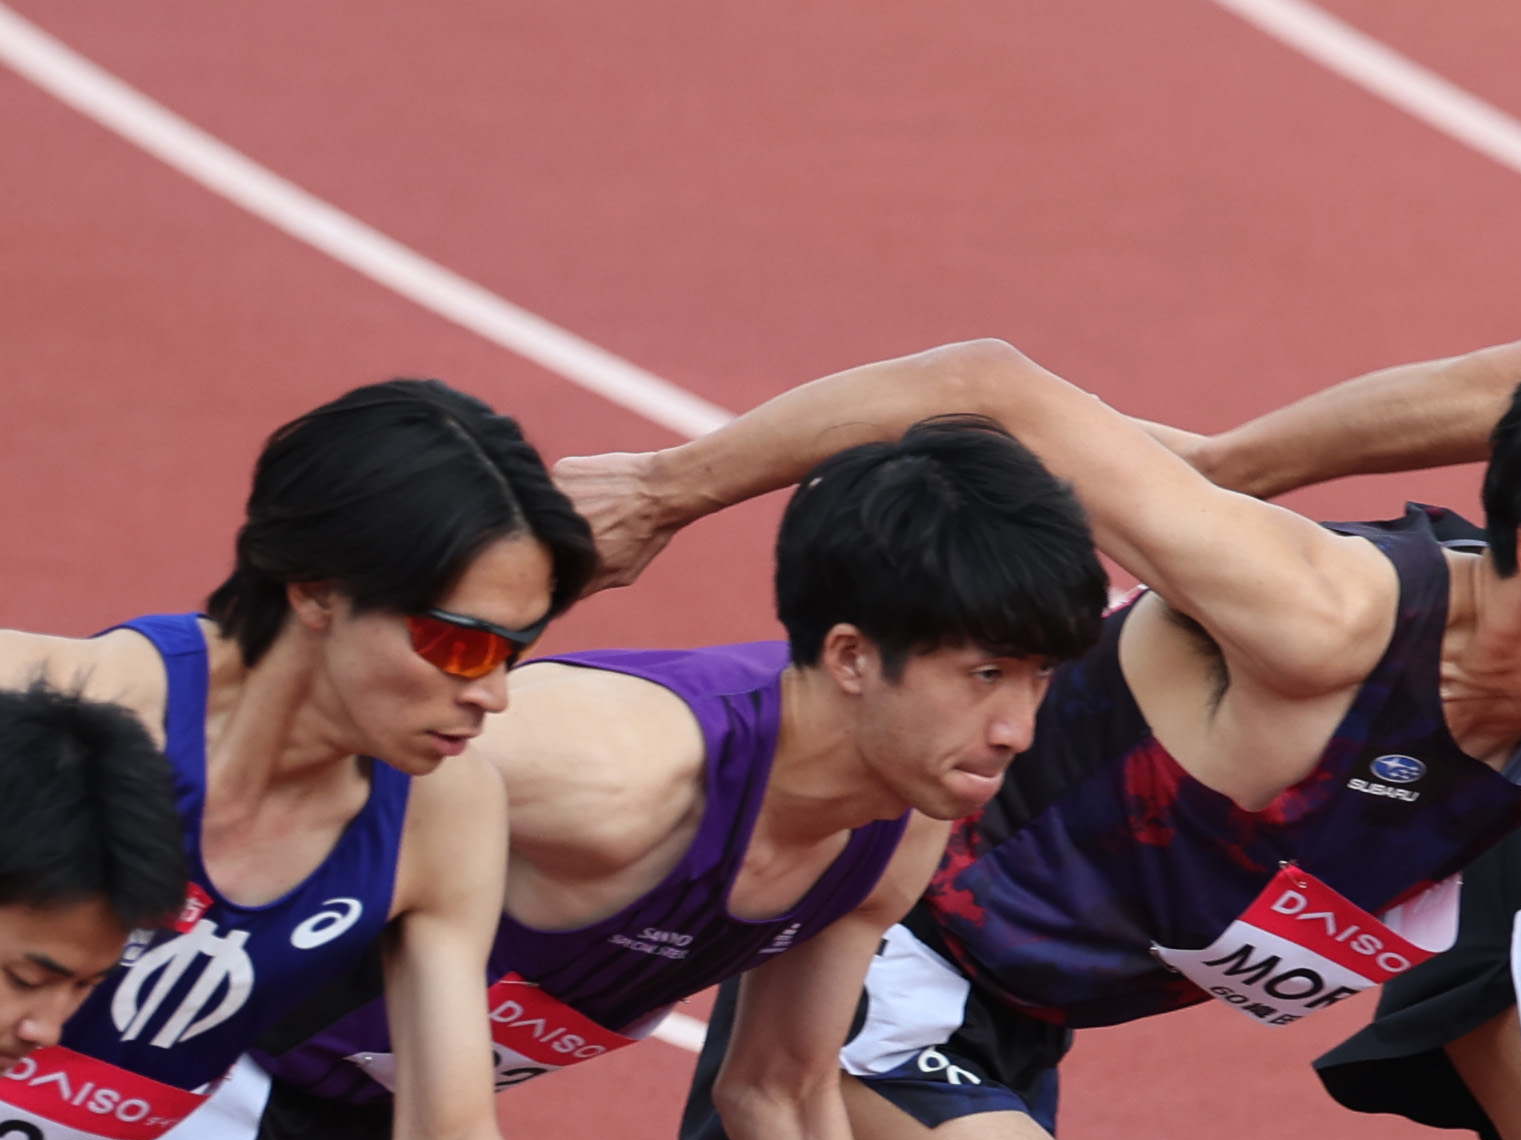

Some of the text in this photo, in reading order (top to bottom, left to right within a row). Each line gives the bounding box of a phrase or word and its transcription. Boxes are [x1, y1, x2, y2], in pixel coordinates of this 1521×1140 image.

[1346, 778, 1421, 802] SUBARU
[1270, 889, 1412, 973] DAISO
[489, 999, 607, 1059] DAISO
[2, 1056, 151, 1123] DAISO
